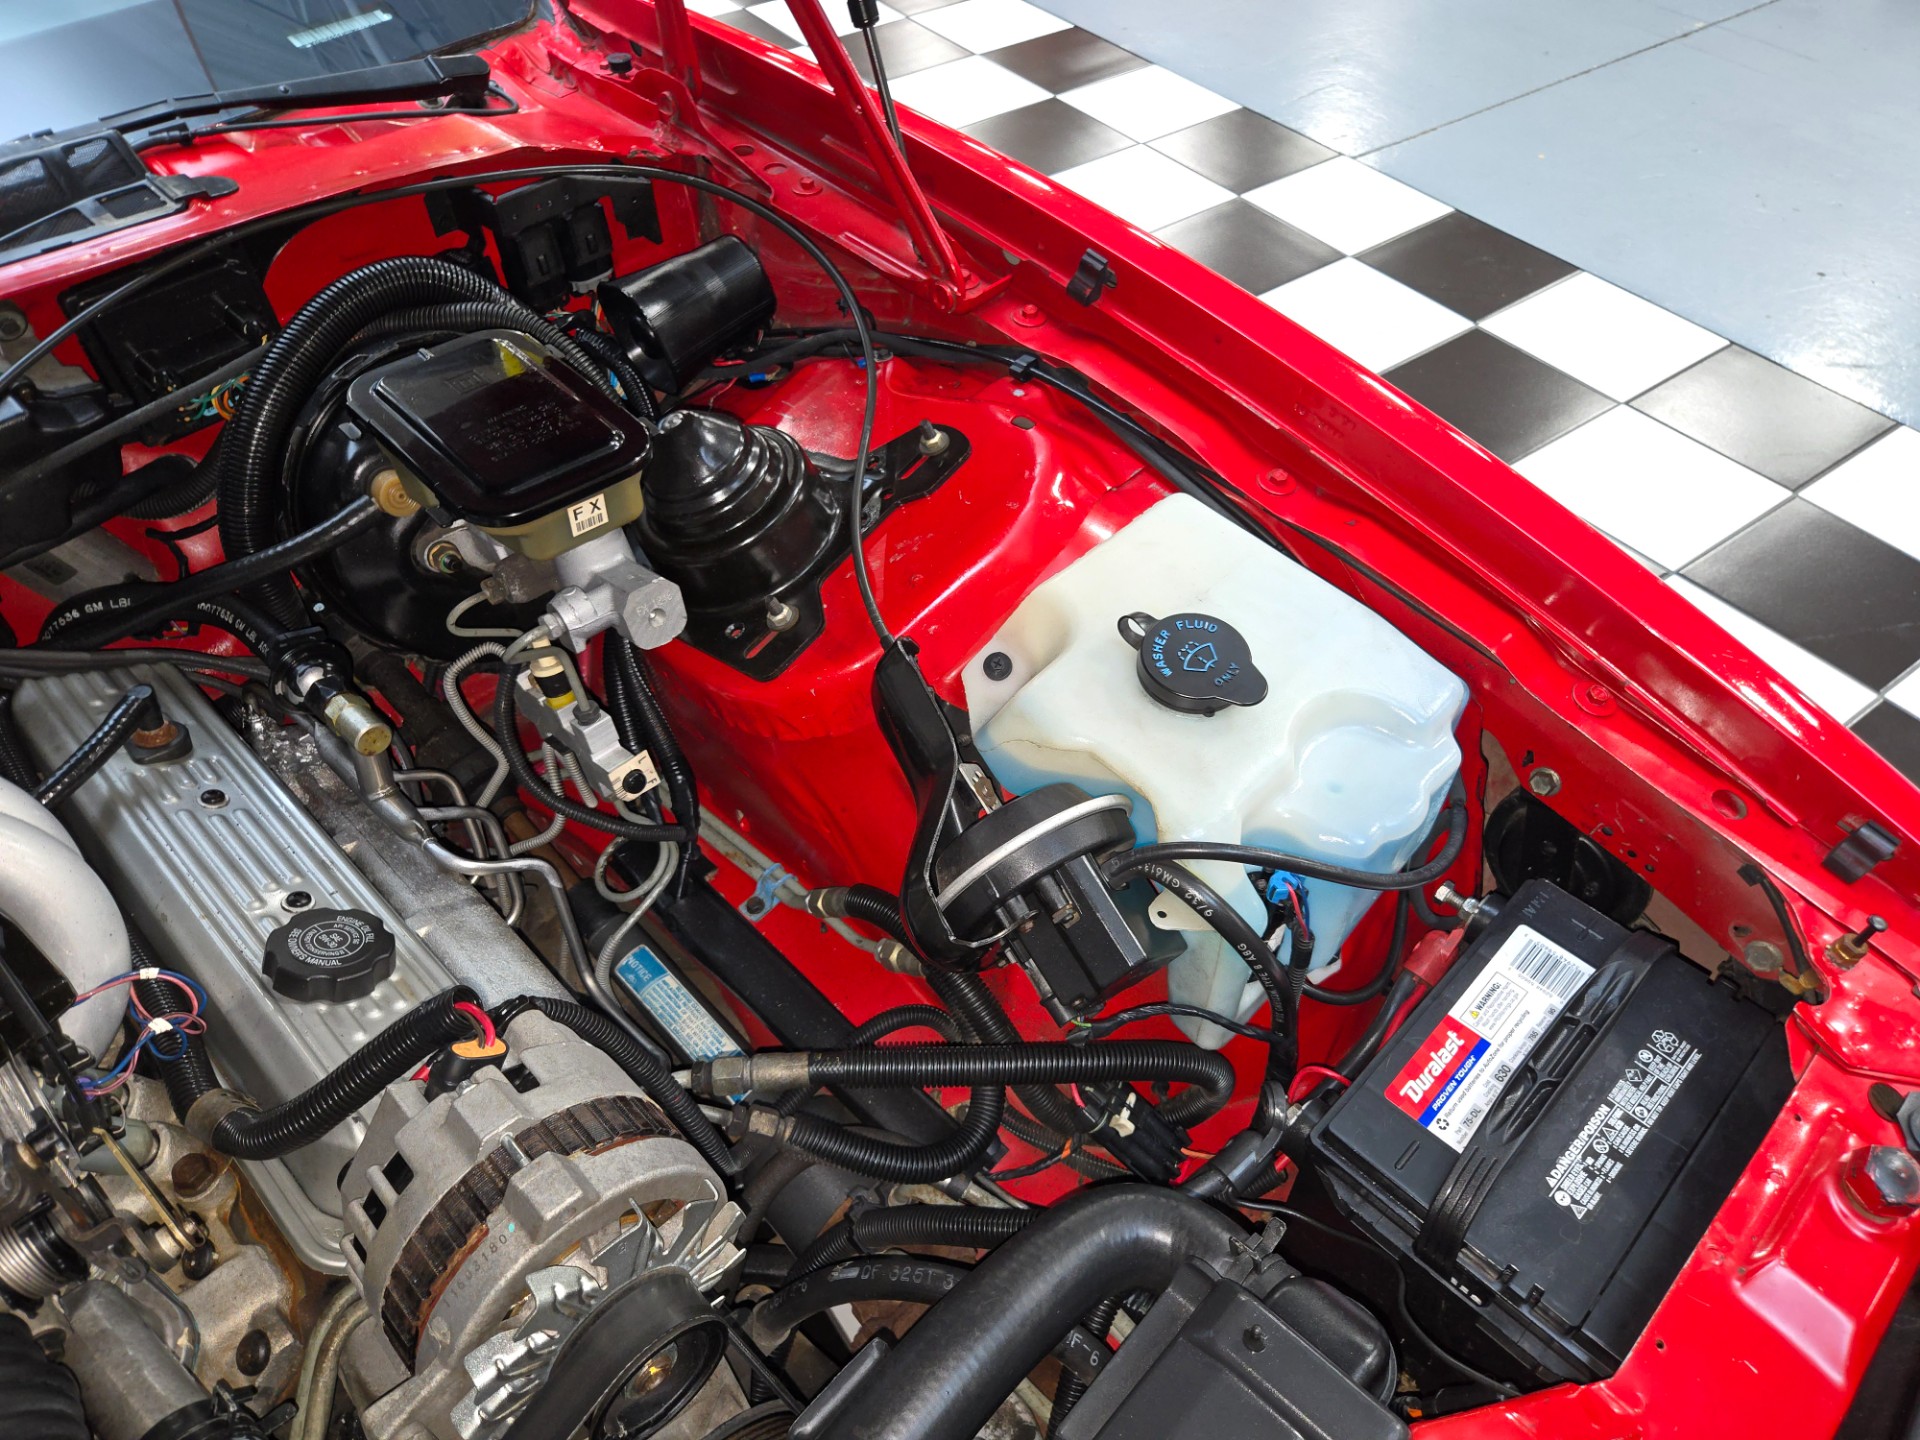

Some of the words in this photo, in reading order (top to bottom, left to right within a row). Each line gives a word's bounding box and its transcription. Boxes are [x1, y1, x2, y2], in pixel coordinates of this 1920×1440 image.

[1152, 629, 1173, 677] WASHER
[1175, 619, 1218, 633] FLUID
[1215, 662, 1241, 686] ONLY
[337, 916, 364, 927] ENGINE
[305, 957, 342, 966] MANUAL
[625, 954, 651, 984] NOTICE
[1475, 983, 1501, 1012] WARNING:
[1547, 1007, 1556, 1016] 95
[1527, 1029, 1538, 1042] 785
[1399, 1030, 1465, 1104] Duralast
[1443, 1101, 1458, 1118] Return
[1455, 1090, 1467, 1103] used
[1463, 1071, 1481, 1092] batteries
[1481, 1046, 1500, 1068] AutoZone
[1502, 1027, 1516, 1042] proper
[1493, 1063, 1512, 1083] 630
[1430, 1079, 1458, 1111] PROVEN
[1462, 1105, 1481, 1128] 75-DL
[1549, 1102, 1610, 1180] DANGER/POISON
